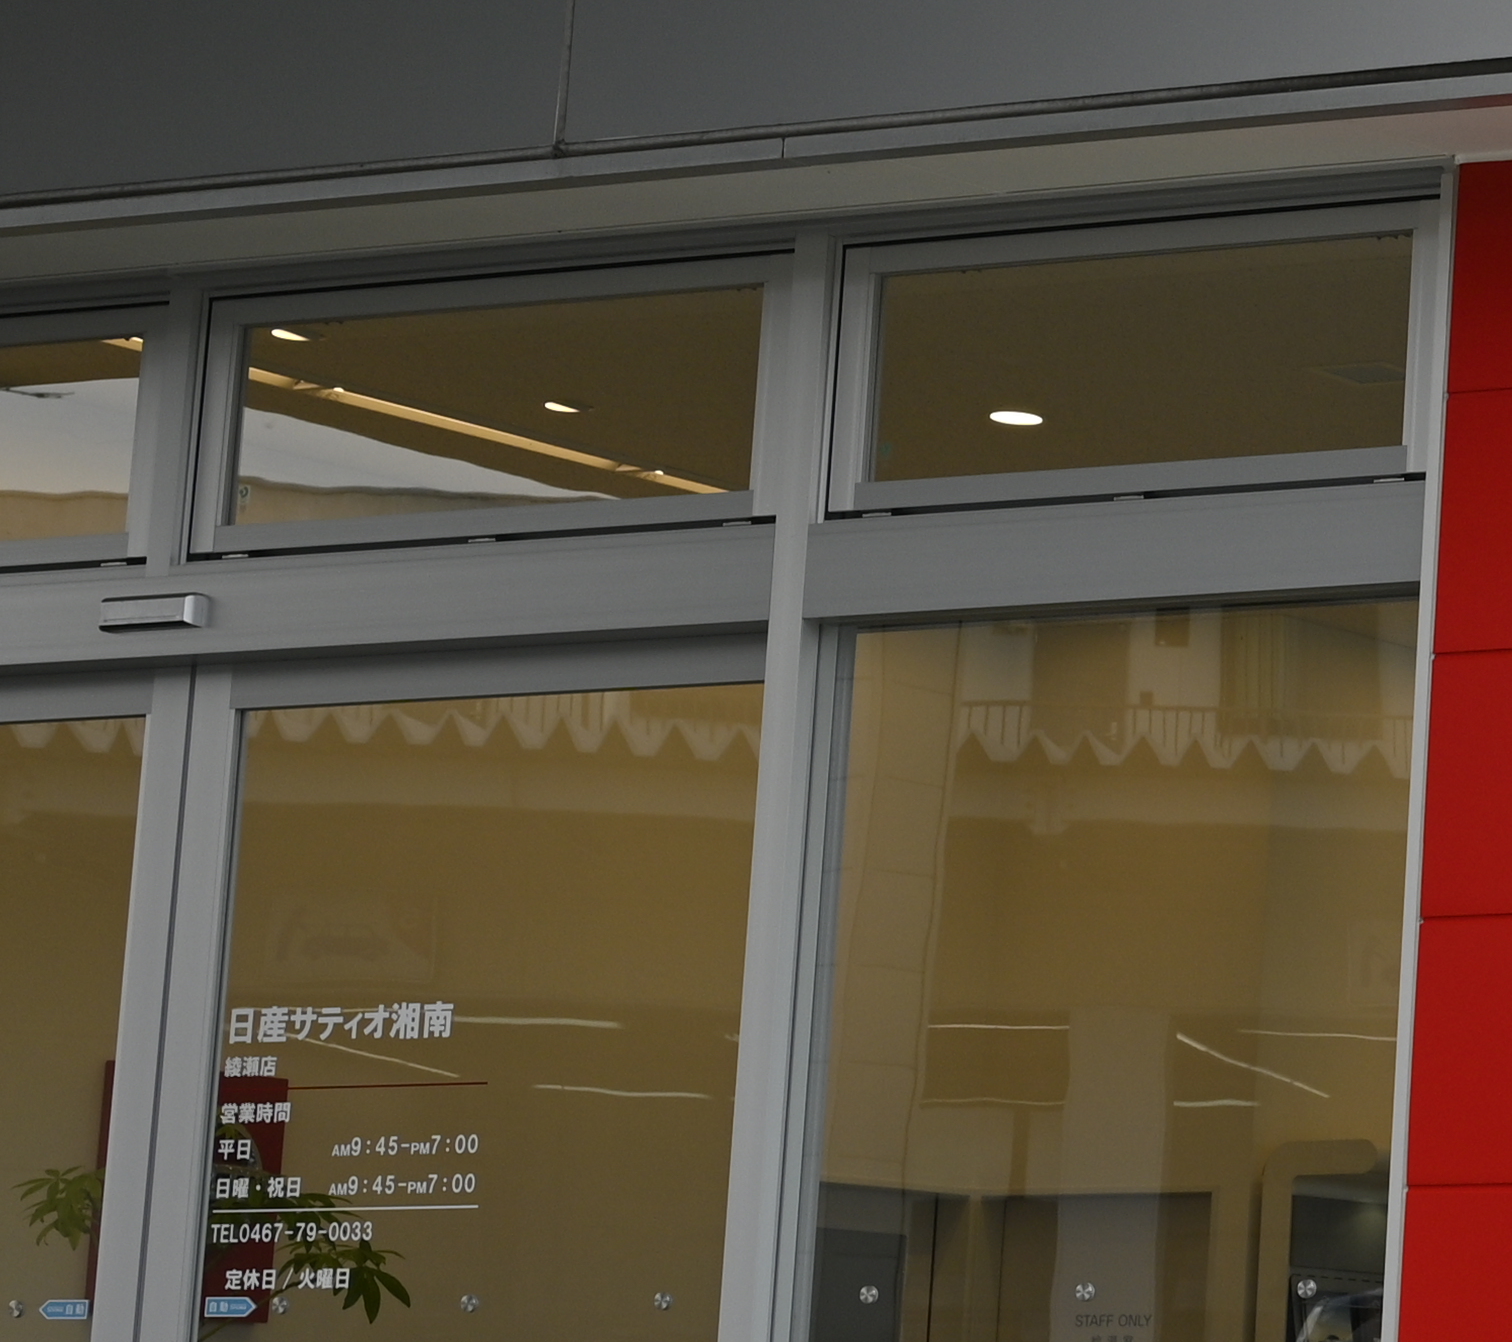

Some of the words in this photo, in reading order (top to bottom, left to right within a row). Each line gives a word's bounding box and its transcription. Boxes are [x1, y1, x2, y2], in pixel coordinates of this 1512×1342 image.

[229, 1001, 454, 1044] 日産サティオ湘南
[224, 1056, 277, 1077] 綾瀬店
[219, 1102, 291, 1124] 営業時間
[217, 1139, 251, 1160] 平日
[215, 1177, 301, 1199] 日曜・祝日
[211, 1221, 373, 1243] TEL0467-79-0033
[1075, 1314, 1114, 1327] STAFF
[1118, 1314, 1152, 1327] ONLY
